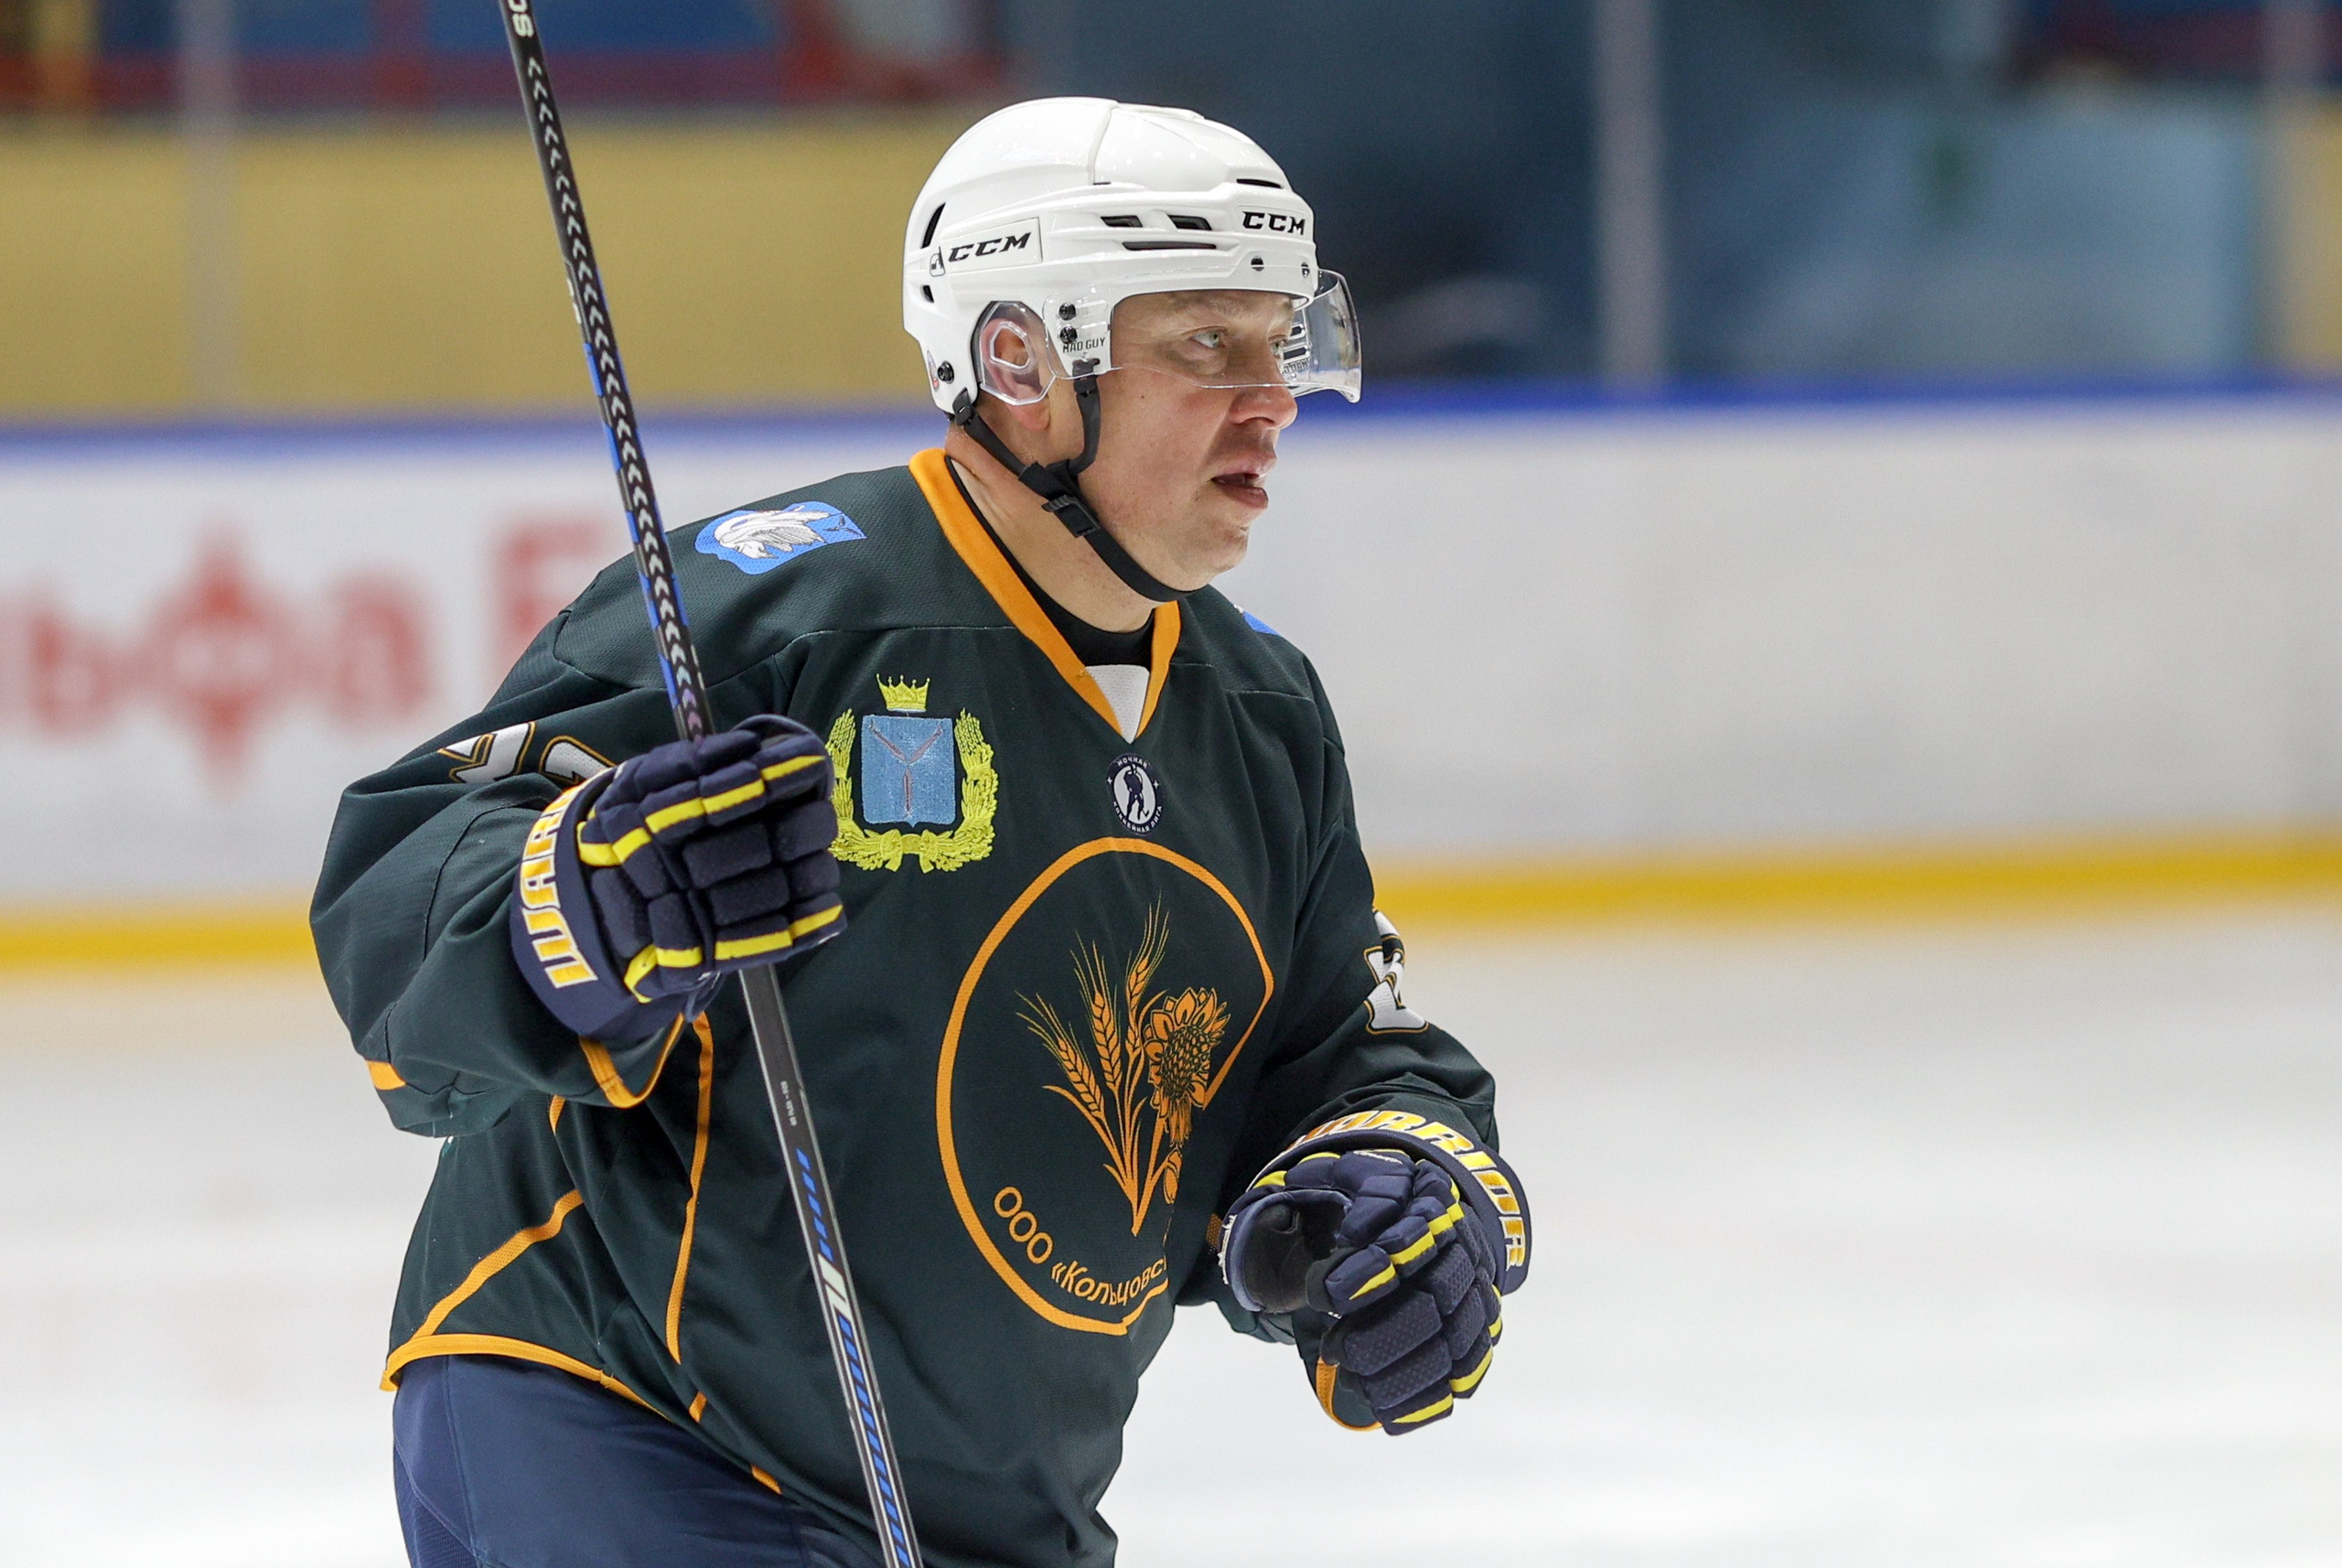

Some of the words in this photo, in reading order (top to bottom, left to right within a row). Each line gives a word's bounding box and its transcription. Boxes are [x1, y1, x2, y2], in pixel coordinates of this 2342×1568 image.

[1242, 211, 1305, 236] CCM
[949, 231, 1032, 263] CCM
[1086, 337, 1106, 349] GUY
[1117, 757, 1148, 768] НОЧНАЯ
[994, 1187, 1053, 1264] ООО
[1051, 1255, 1166, 1306] «Кольцовс
